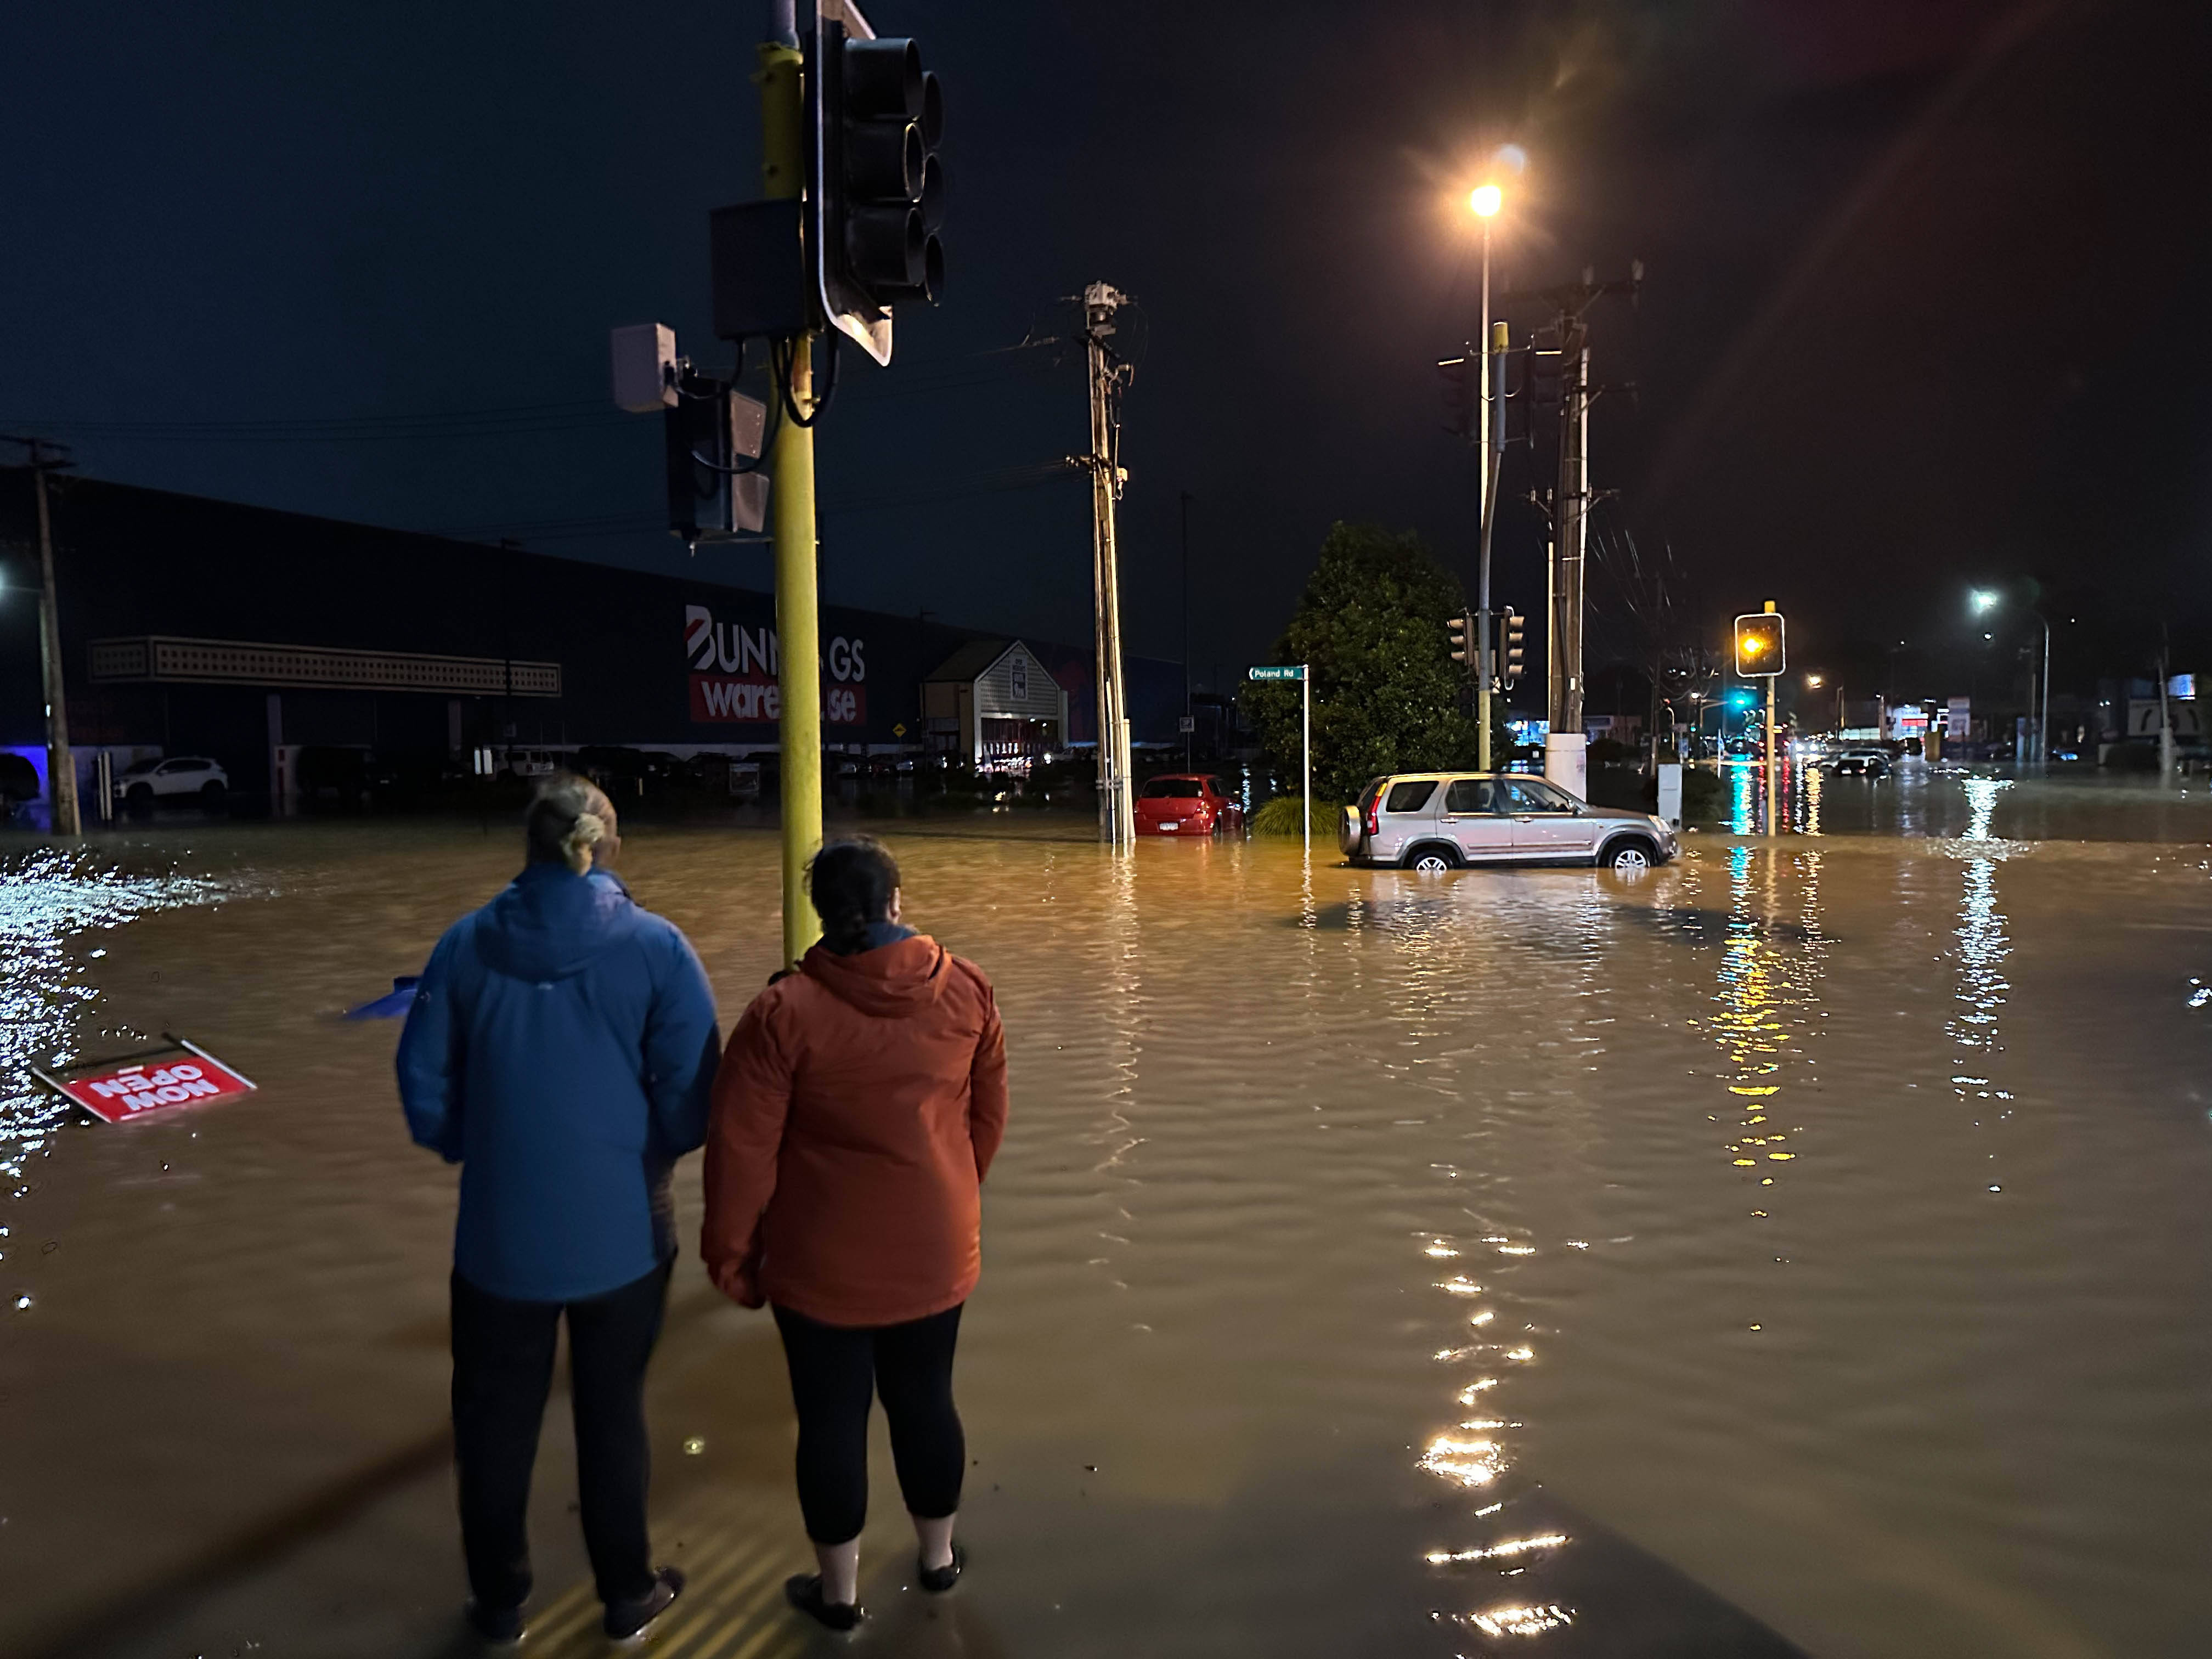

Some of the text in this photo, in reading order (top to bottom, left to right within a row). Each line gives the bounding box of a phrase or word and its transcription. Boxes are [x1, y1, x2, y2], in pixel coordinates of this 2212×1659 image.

[684, 605, 865, 682] BUNGS
[1255, 669, 1294, 678] Poland Rd
[89, 1065, 202, 1097] OPEN
[122, 1079, 219, 1110] NOW
